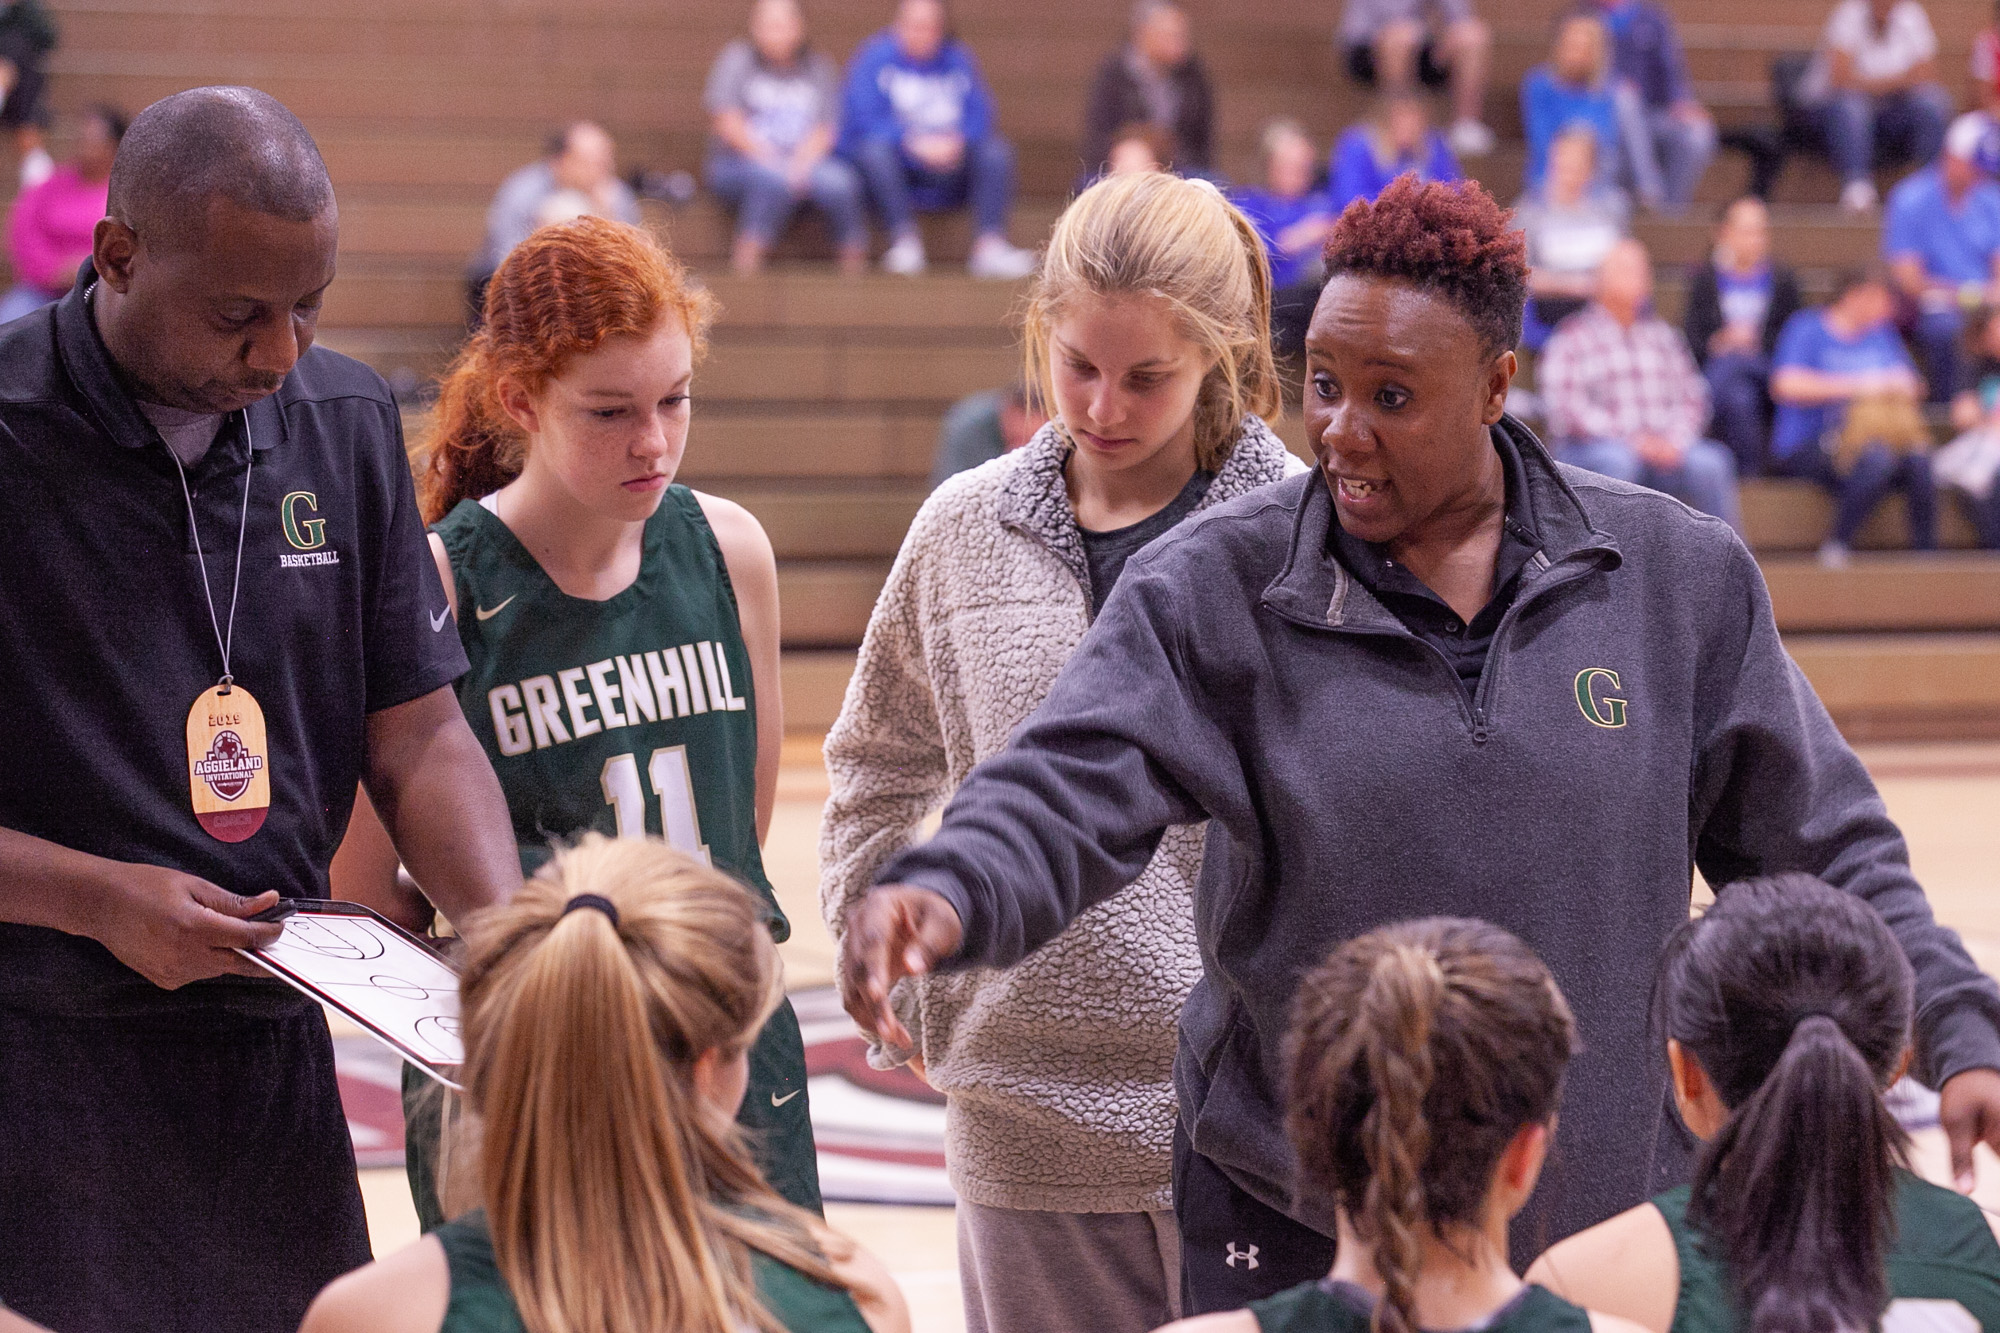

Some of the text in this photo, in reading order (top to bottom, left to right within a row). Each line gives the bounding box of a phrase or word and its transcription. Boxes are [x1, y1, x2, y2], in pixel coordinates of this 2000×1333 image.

[282, 490, 326, 550] G
[280, 550, 340, 568] BASKETBALL
[488, 640, 747, 757] GREENHILL
[1574, 667, 1628, 729] G
[208, 713, 241, 727] 2019
[195, 756, 262, 775] AGGIELAND
[205, 770, 254, 782] INVITATIONAL
[600, 744, 713, 870] 11
